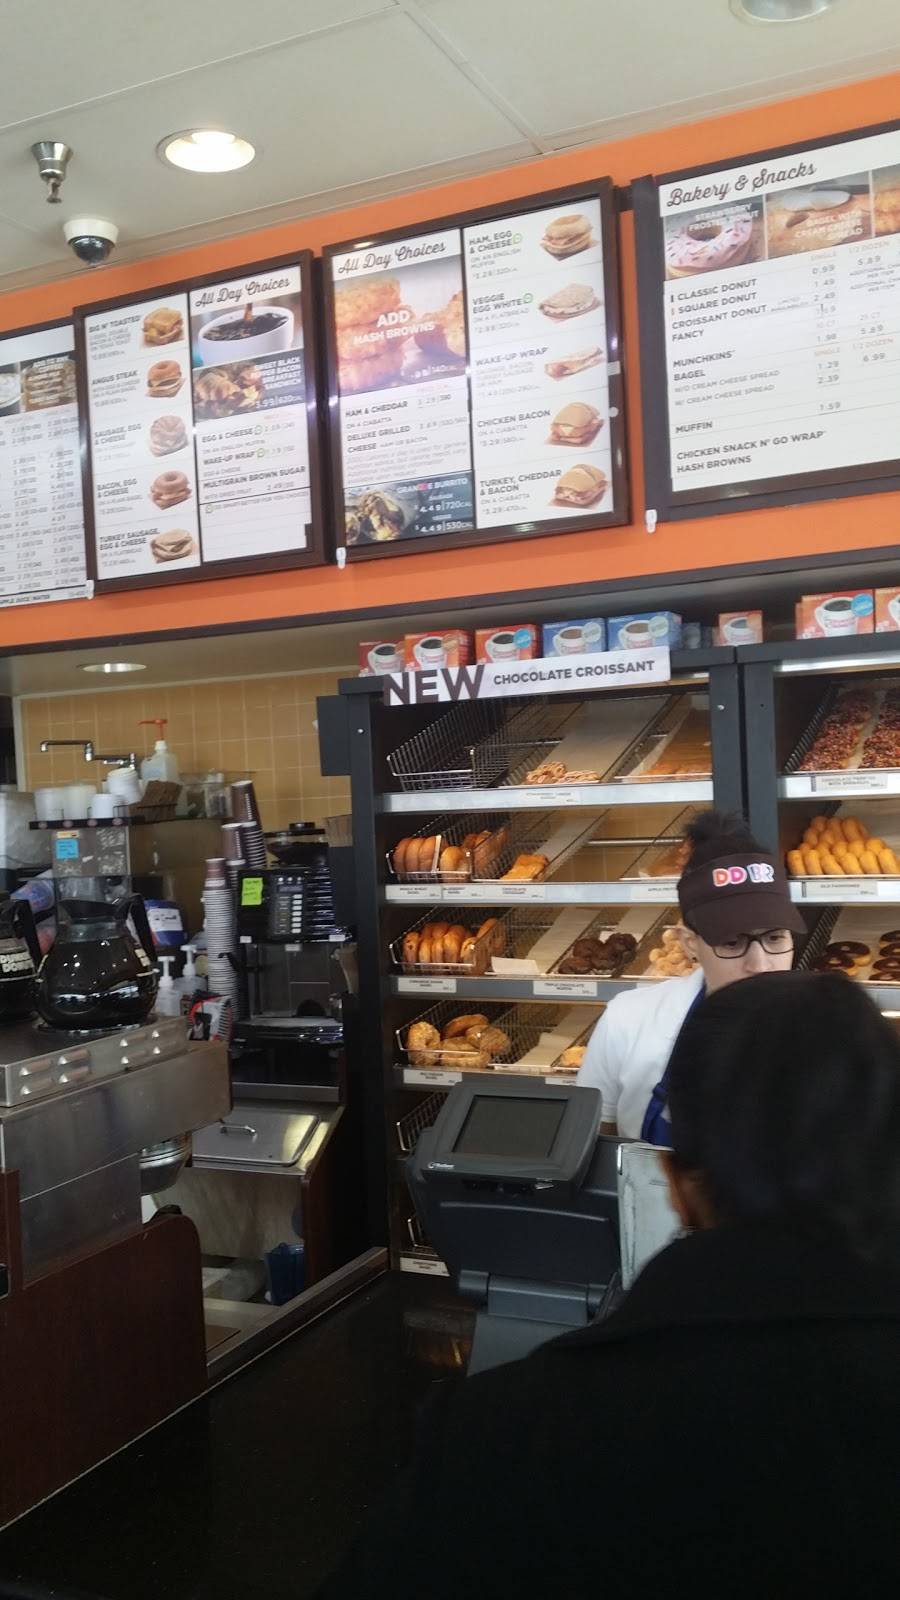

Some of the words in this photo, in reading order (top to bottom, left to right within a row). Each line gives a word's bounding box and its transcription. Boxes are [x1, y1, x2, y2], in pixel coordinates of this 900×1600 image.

[666, 181, 730, 207] Bakery
[734, 175, 749, 190] &
[752, 162, 817, 191] Snacks
[477, 239, 512, 252] CHEESE
[338, 258, 359, 274] All
[363, 252, 391, 268] Day
[395, 242, 446, 262] Choices
[196, 292, 214, 307] All
[217, 287, 241, 302] Day
[245, 278, 290, 295] Choices
[678, 286, 718, 300] CLASSIC
[722, 278, 757, 292] DONUT
[472, 293, 504, 306] VEGGIE
[473, 306, 491, 314] EGG
[494, 298, 522, 310] WHITE
[678, 300, 718, 314] SQUARE
[722, 292, 757, 306] DONUT
[377, 310, 410, 328] ADD
[672, 312, 728, 330] CROISSANT
[731, 305, 767, 318] DONUT
[353, 330, 384, 344] HASH
[387, 322, 435, 338] BROWNS
[672, 330, 704, 342] FANCY
[673, 350, 733, 368] MUNCHKINS
[116, 370, 138, 380] STEAK
[674, 370, 706, 381] BAGEL
[687, 395, 712, 404] CREAM
[818, 374, 839, 384] 2.39
[692, 381, 717, 390] CREAM
[372, 401, 408, 413] CHEDDAR
[477, 415, 516, 427] CHICKEN
[518, 410, 550, 421] BACON
[347, 432, 376, 442] DELUXE
[379, 426, 410, 437] GRILLED
[676, 421, 713, 434] MUFFIN
[348, 443, 376, 452] CHEESE
[677, 447, 720, 460] CHICKEN
[723, 441, 757, 454] SNACK
[773, 436, 788, 446] GO
[792, 430, 824, 443] WRAP
[677, 462, 704, 474] HASH
[707, 455, 752, 470] BROWNS
[203, 477, 247, 488] MULTIGRAIN
[249, 472, 278, 482] BROWN
[280, 466, 306, 476] SUGAR
[434, 478, 468, 489] BURRITO
[480, 476, 516, 488] TURKEY,
[518, 470, 562, 482] CHEDDAR
[488, 484, 520, 495] BACON
[100, 534, 126, 544] TURKEY
[100, 543, 114, 551] EGG
[122, 538, 146, 547] CHEESE
[383, 664, 485, 706] NEW
[494, 668, 572, 686] CHOCOLATE
[576, 660, 655, 678] CROISSANT
